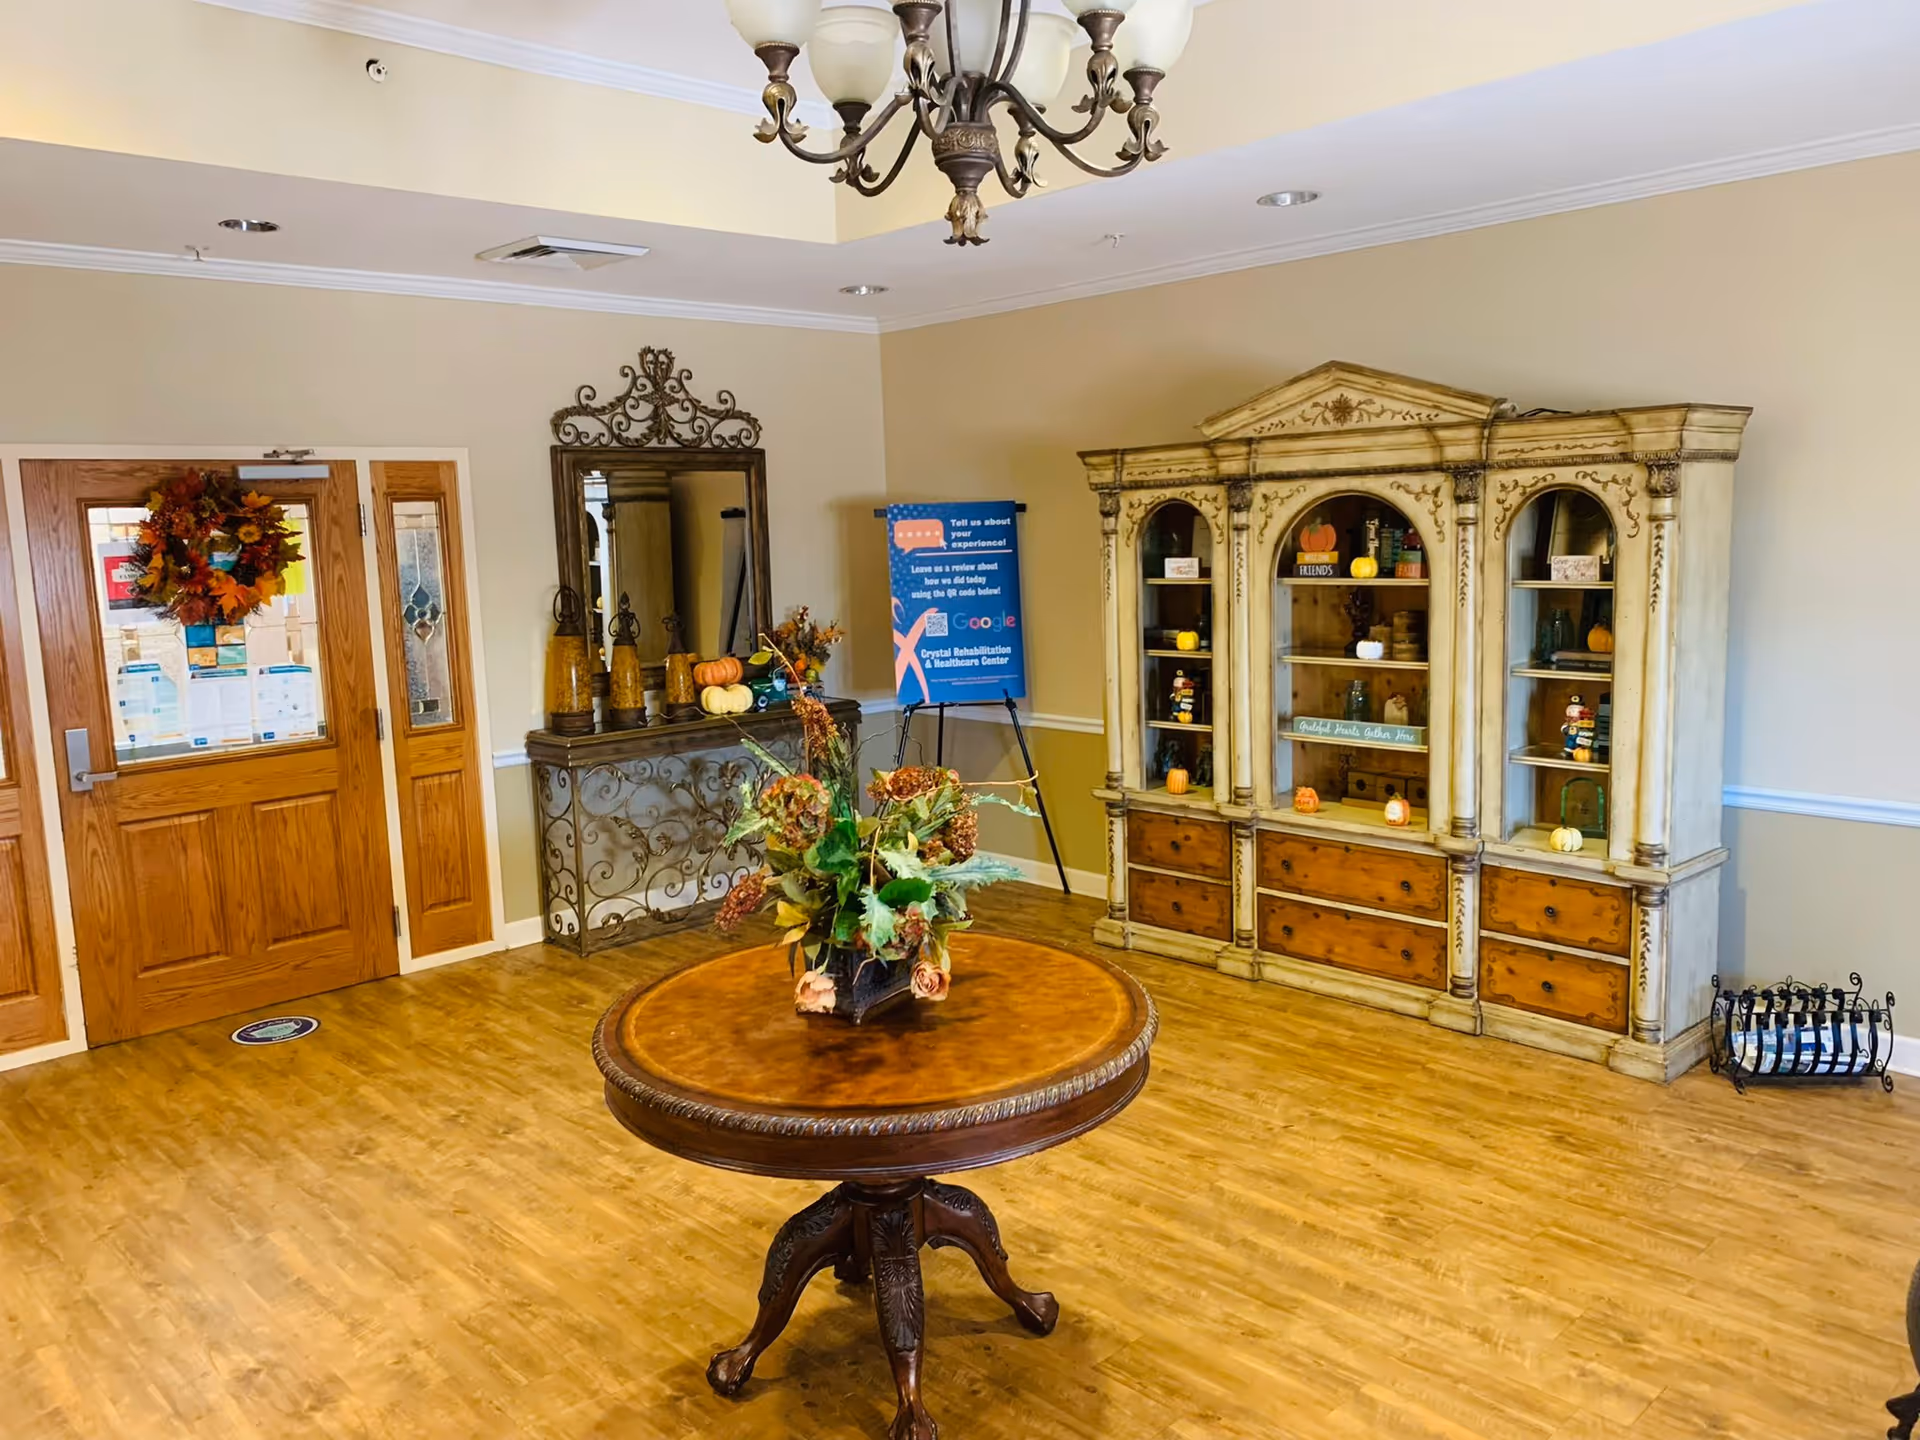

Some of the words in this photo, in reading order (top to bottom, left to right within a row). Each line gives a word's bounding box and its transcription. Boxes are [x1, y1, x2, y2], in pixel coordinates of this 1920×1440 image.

[950, 519, 968, 527] Tell
[984, 518, 1011, 526] about
[951, 530, 972, 539] your
[951, 539, 1006, 550] experience!
[911, 565, 932, 574] Leave
[934, 565, 943, 573] us
[952, 563, 976, 572] review
[977, 562, 998, 571] about
[1300, 565, 1333, 576] FRIENDS
[924, 577, 939, 586] how
[953, 576, 965, 584] did
[966, 575, 987, 585] today
[911, 590, 932, 600] using
[933, 589, 945, 598] the
[947, 589, 957, 599] QR
[959, 588, 976, 597] code
[977, 587, 1001, 596] below!
[953, 609, 1016, 632] Google
[921, 648, 951, 660] Crystal
[954, 645, 1011, 657] Rehabilitation
[925, 660, 932, 669] &
[934, 658, 979, 668] Healthcare
[982, 656, 1009, 666] Center
[1300, 720, 1331, 734] Grateful
[1334, 723, 1360, 737] Hearts
[1364, 726, 1391, 740] Gather
[1395, 729, 1416, 741] Here
